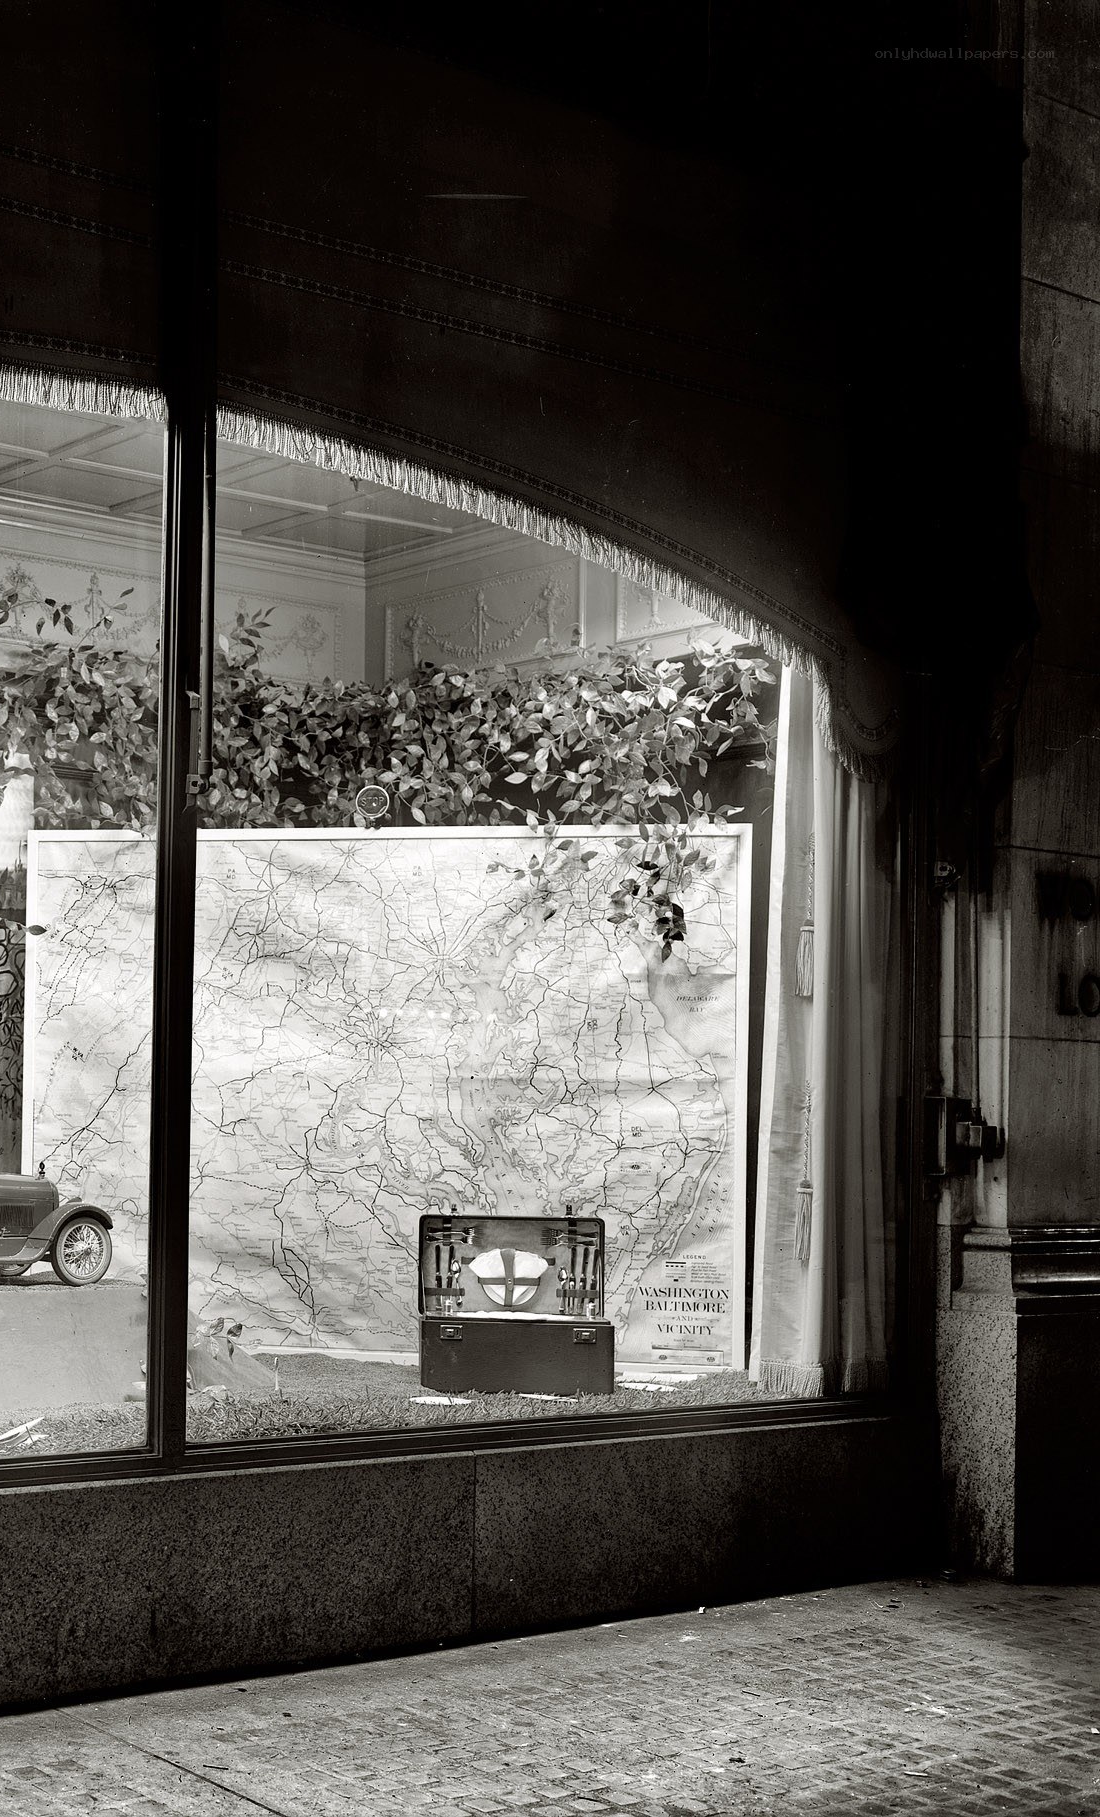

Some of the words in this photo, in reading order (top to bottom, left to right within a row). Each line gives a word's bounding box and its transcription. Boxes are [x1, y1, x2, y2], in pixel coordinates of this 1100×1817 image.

[361, 796, 385, 807] STOP
[691, 1171, 721, 1239] ATLANTIC
[708, 1187, 729, 1233] OCEAN
[639, 1286, 730, 1300] WASHINGTON
[644, 1300, 726, 1314] BALTIMORE
[657, 1324, 714, 1336] VICINITY
